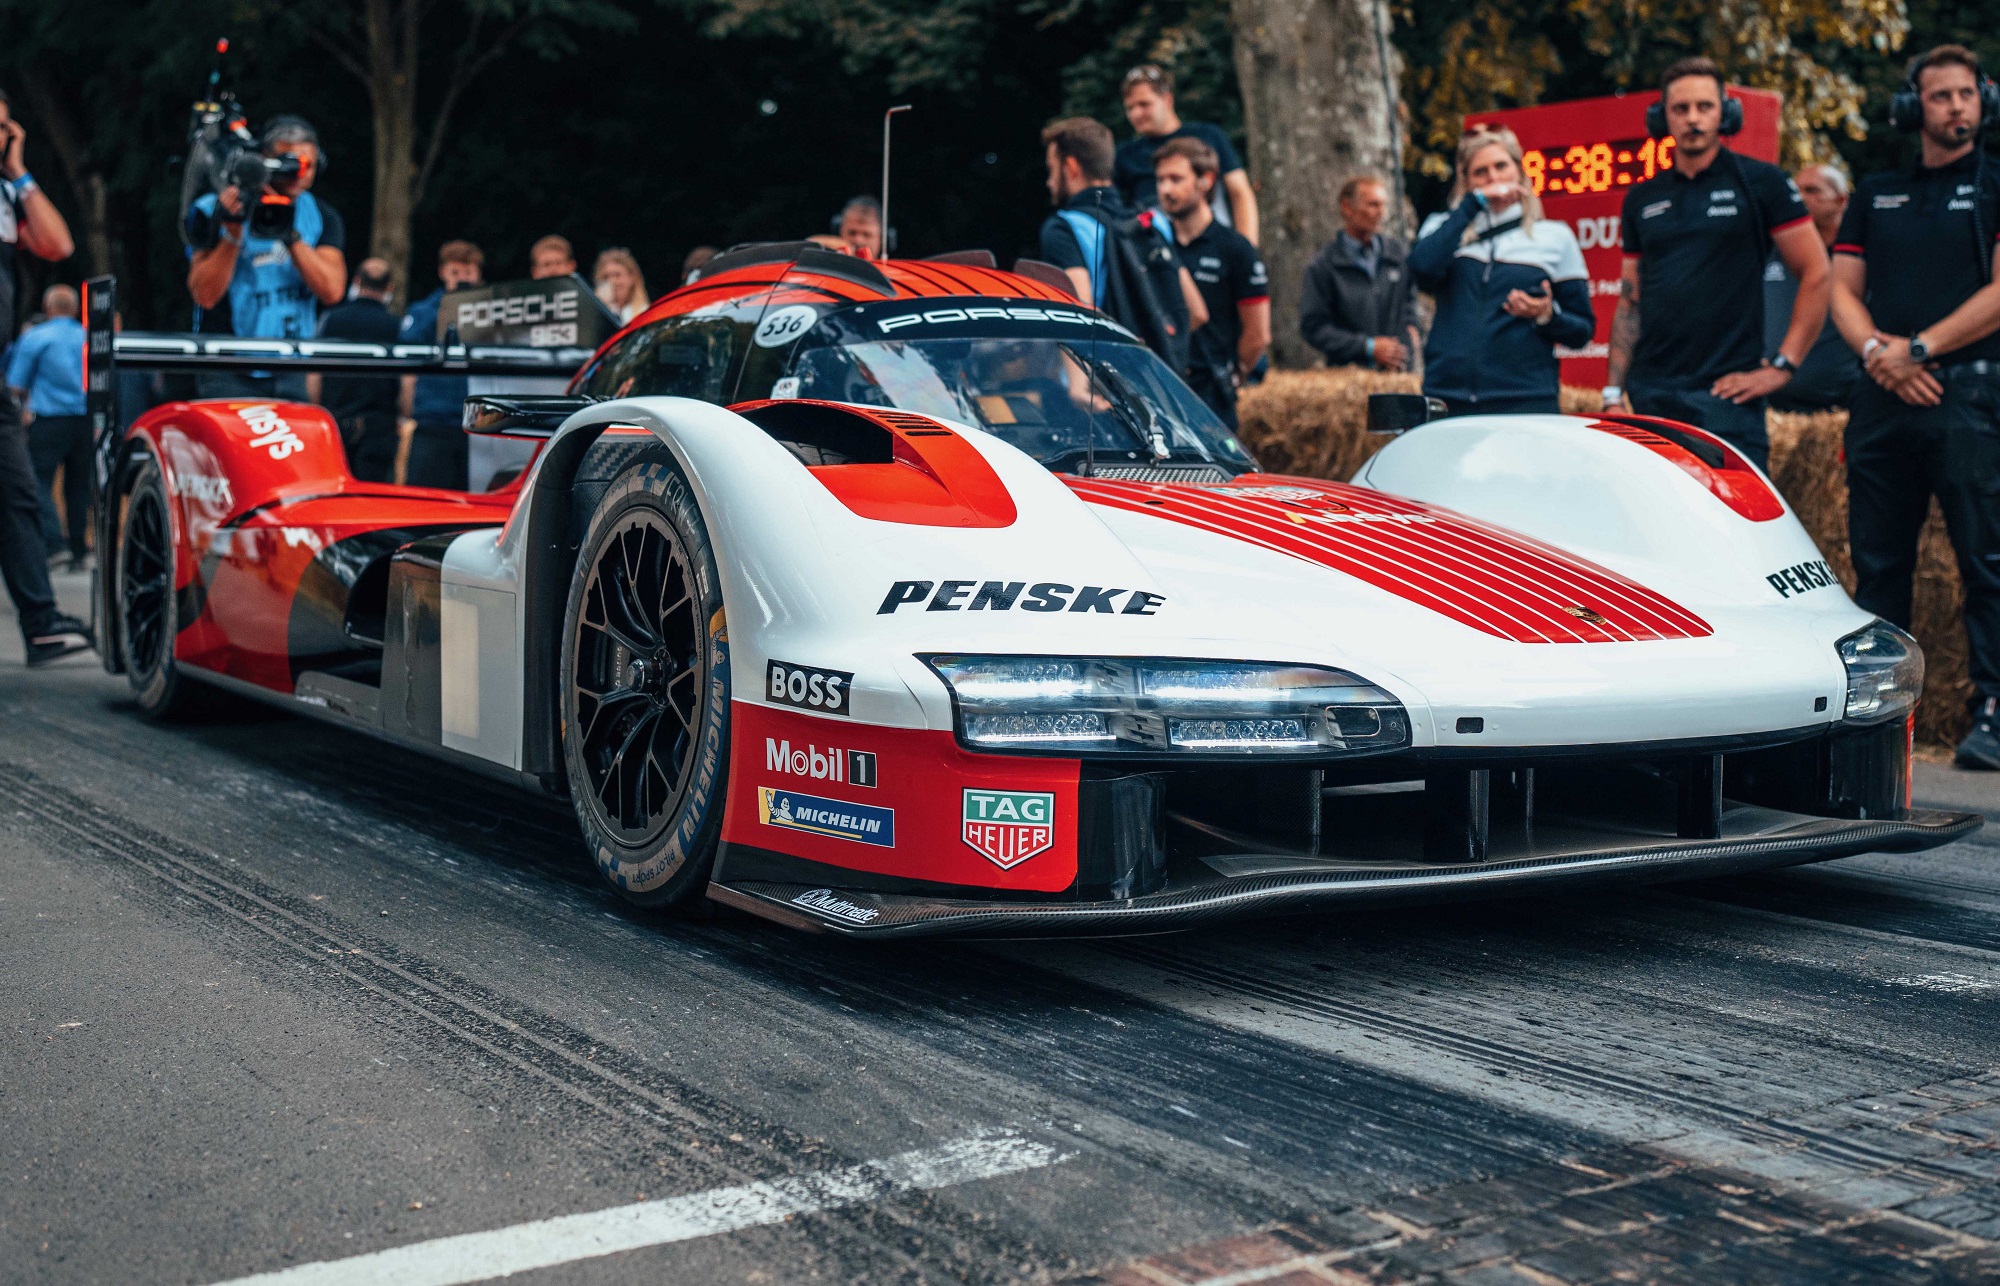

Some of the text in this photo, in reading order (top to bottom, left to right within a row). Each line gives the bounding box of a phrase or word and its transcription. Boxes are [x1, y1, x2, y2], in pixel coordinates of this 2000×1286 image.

[457, 290, 579, 329] PORSCHE
[762, 315, 806, 337] 536
[876, 580, 1167, 616] PENSKE
[771, 666, 843, 709] BOSS
[681, 675, 725, 843] MICHELIN
[766, 737, 867, 784] Mobil 1
[796, 806, 882, 834] MICHELIN
[971, 795, 1045, 821] TAG
[968, 824, 1047, 862] HEUER
[632, 848, 676, 884] PILOT SPORT
